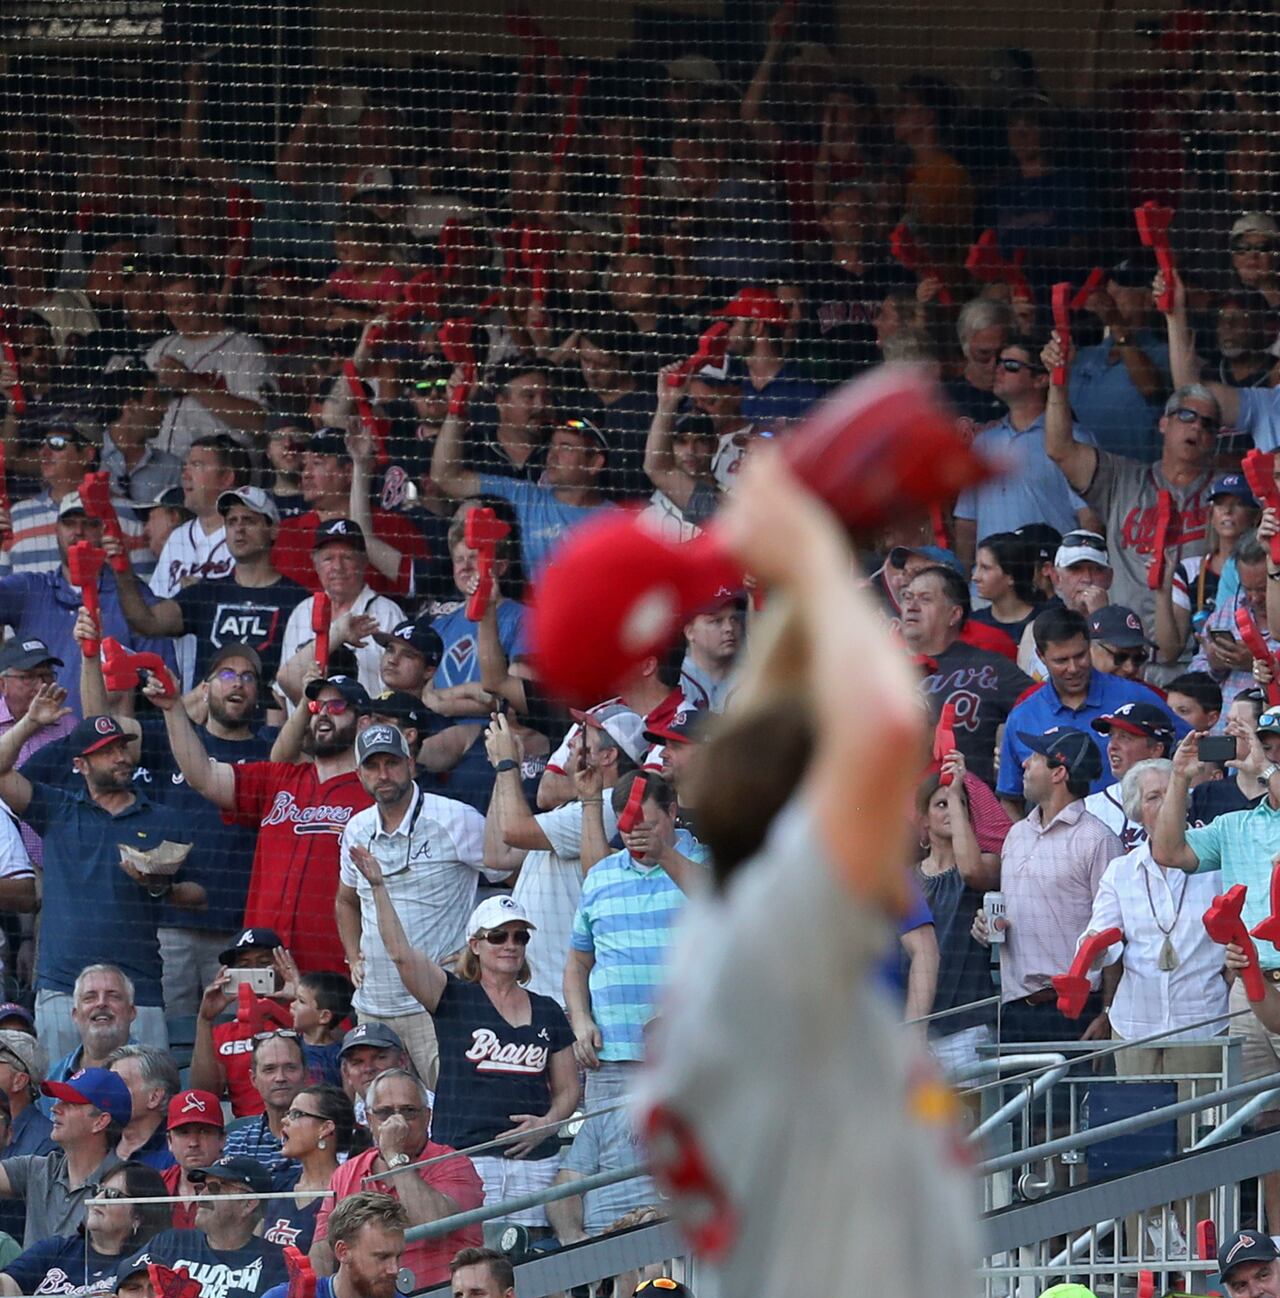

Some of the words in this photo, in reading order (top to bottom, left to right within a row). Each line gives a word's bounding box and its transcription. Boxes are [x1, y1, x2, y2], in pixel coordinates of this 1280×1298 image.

[327, 521, 347, 535] A
[220, 616, 267, 636] ATL
[262, 792, 354, 826] Braves
[411, 840, 432, 859] A
[236, 929, 254, 946] A
[465, 1028, 549, 1068] Braves
[132, 1253, 151, 1267] A
